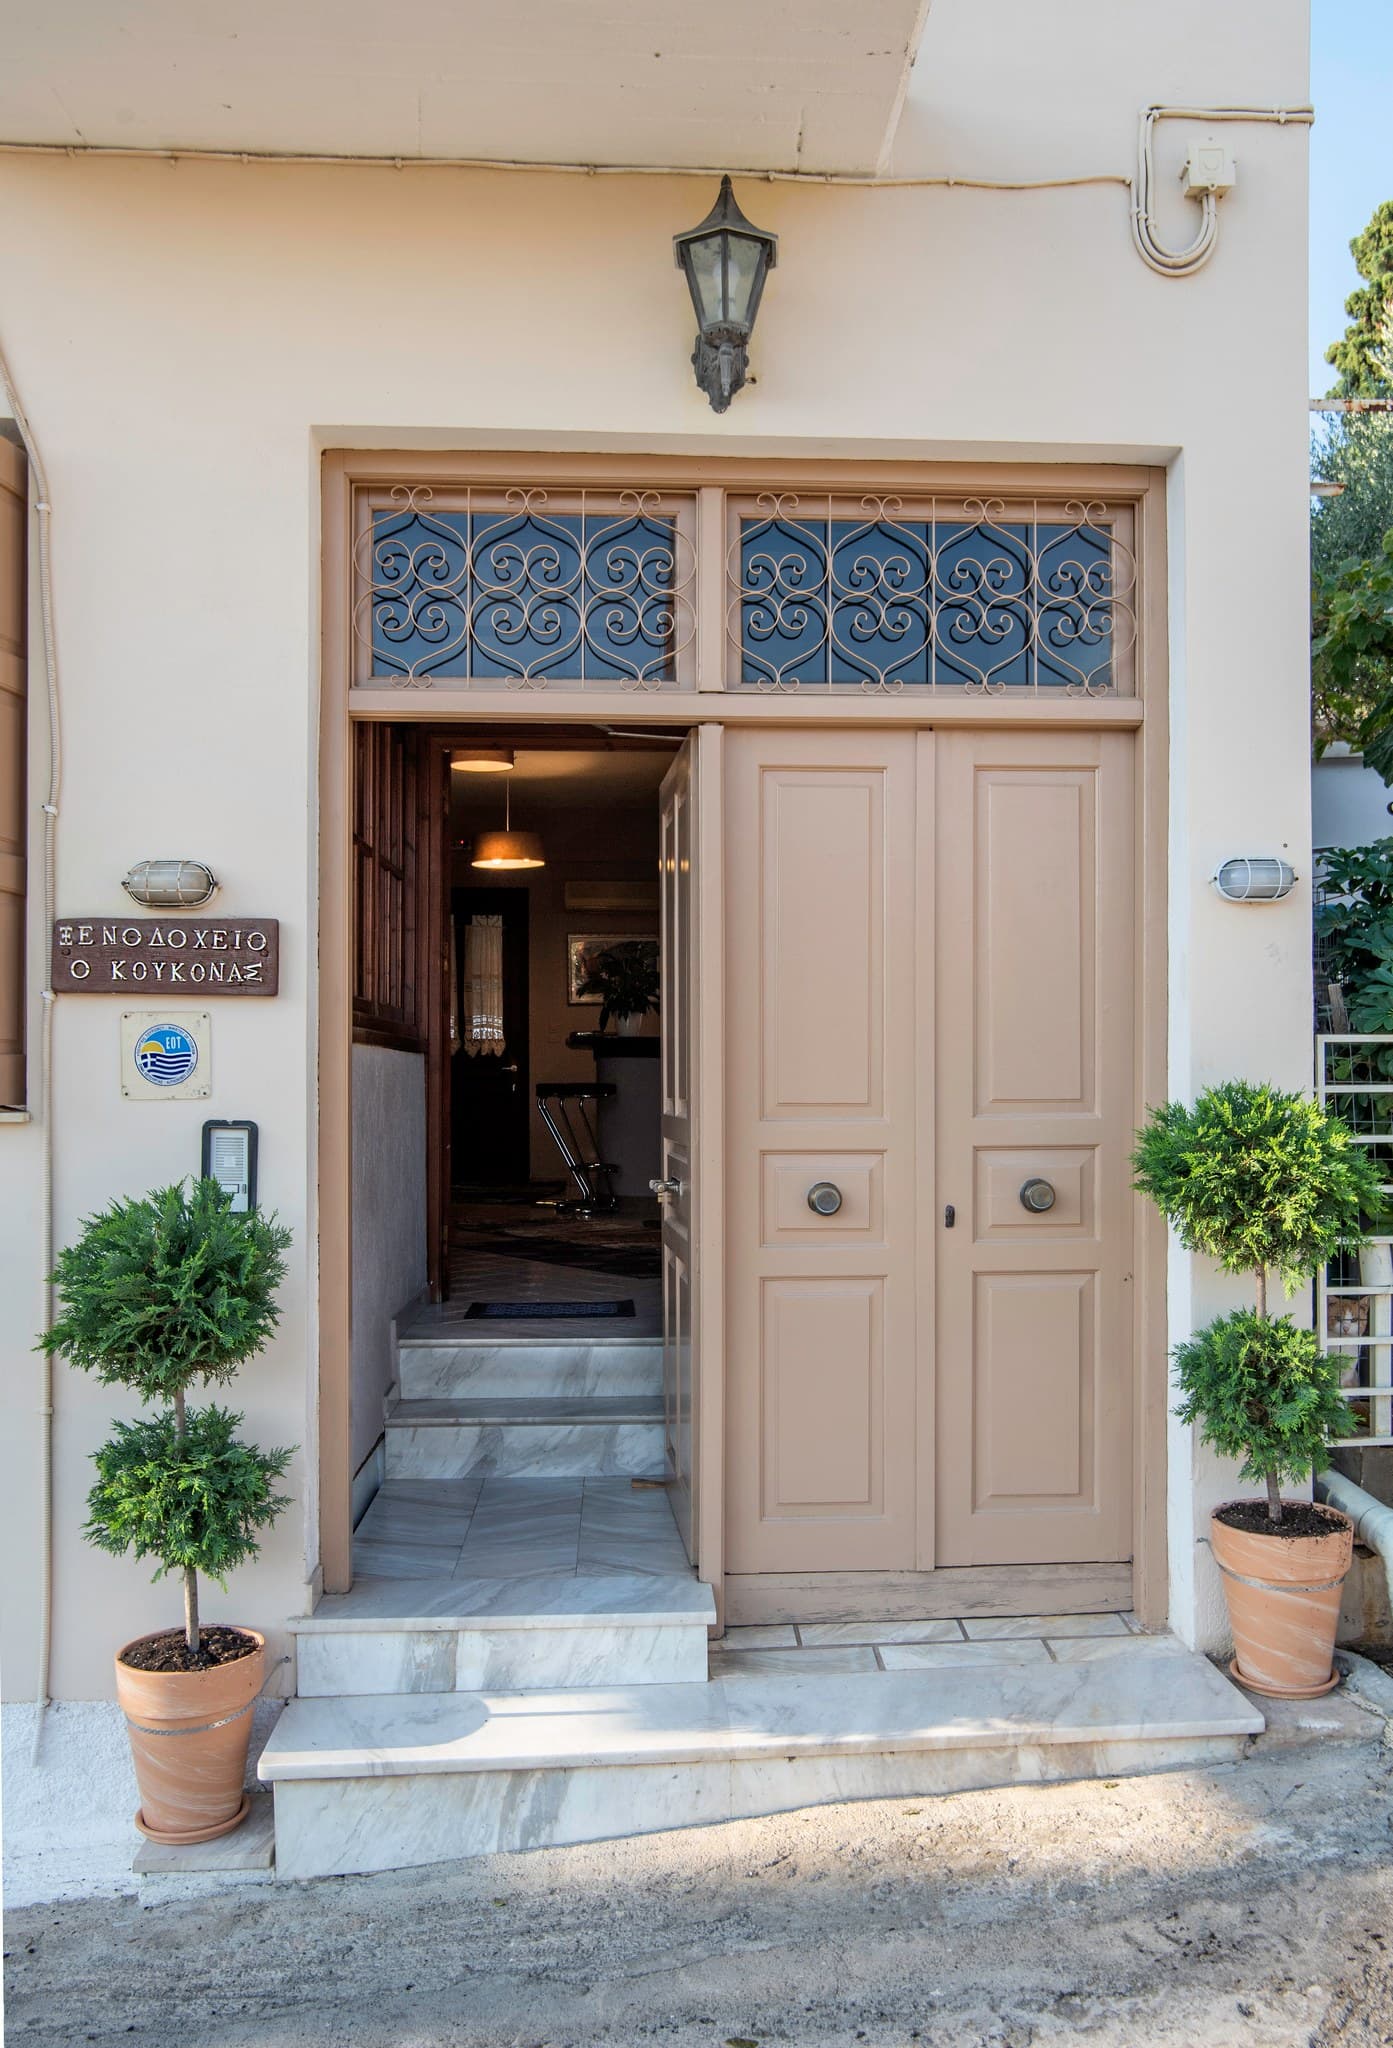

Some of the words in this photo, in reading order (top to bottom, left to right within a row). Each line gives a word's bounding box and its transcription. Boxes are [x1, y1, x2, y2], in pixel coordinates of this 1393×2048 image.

[59, 925, 267, 951] ΞΕΝΟΔΟΧΕΙΟ
[70, 959, 91, 979] Ο
[165, 1036, 182, 1050] ΕΟΤ
